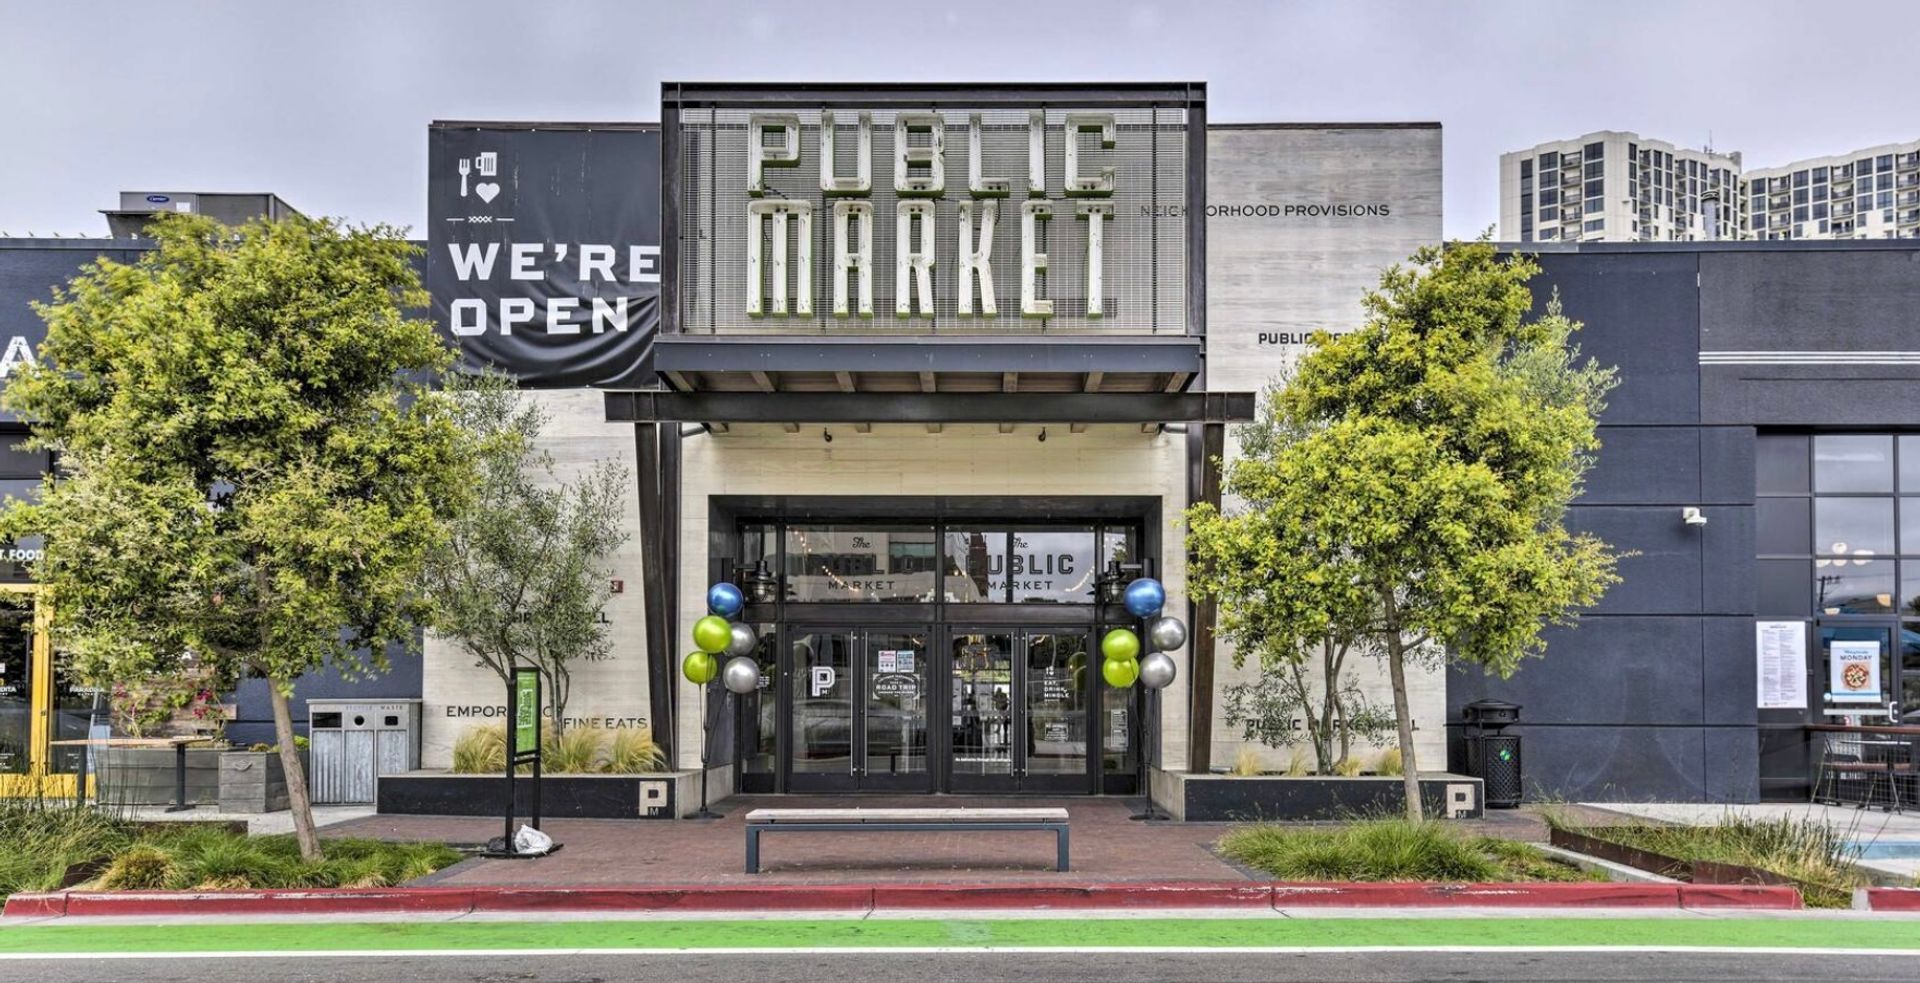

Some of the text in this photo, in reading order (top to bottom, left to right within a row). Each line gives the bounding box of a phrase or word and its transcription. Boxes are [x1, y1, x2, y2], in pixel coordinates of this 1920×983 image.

[748, 112, 1116, 197] PUBLIC
[1285, 204, 1390, 217] PROVISIONS
[746, 200, 1114, 318] MARKET
[450, 297, 629, 336] OPEN
[828, 581, 895, 590] MARKET
[987, 581, 1053, 590] MARKET
[812, 667, 835, 696] P
[564, 717, 647, 729] FINE EATS
[639, 781, 667, 816] P
[650, 807, 659, 816] M
[1447, 784, 1475, 818] P
